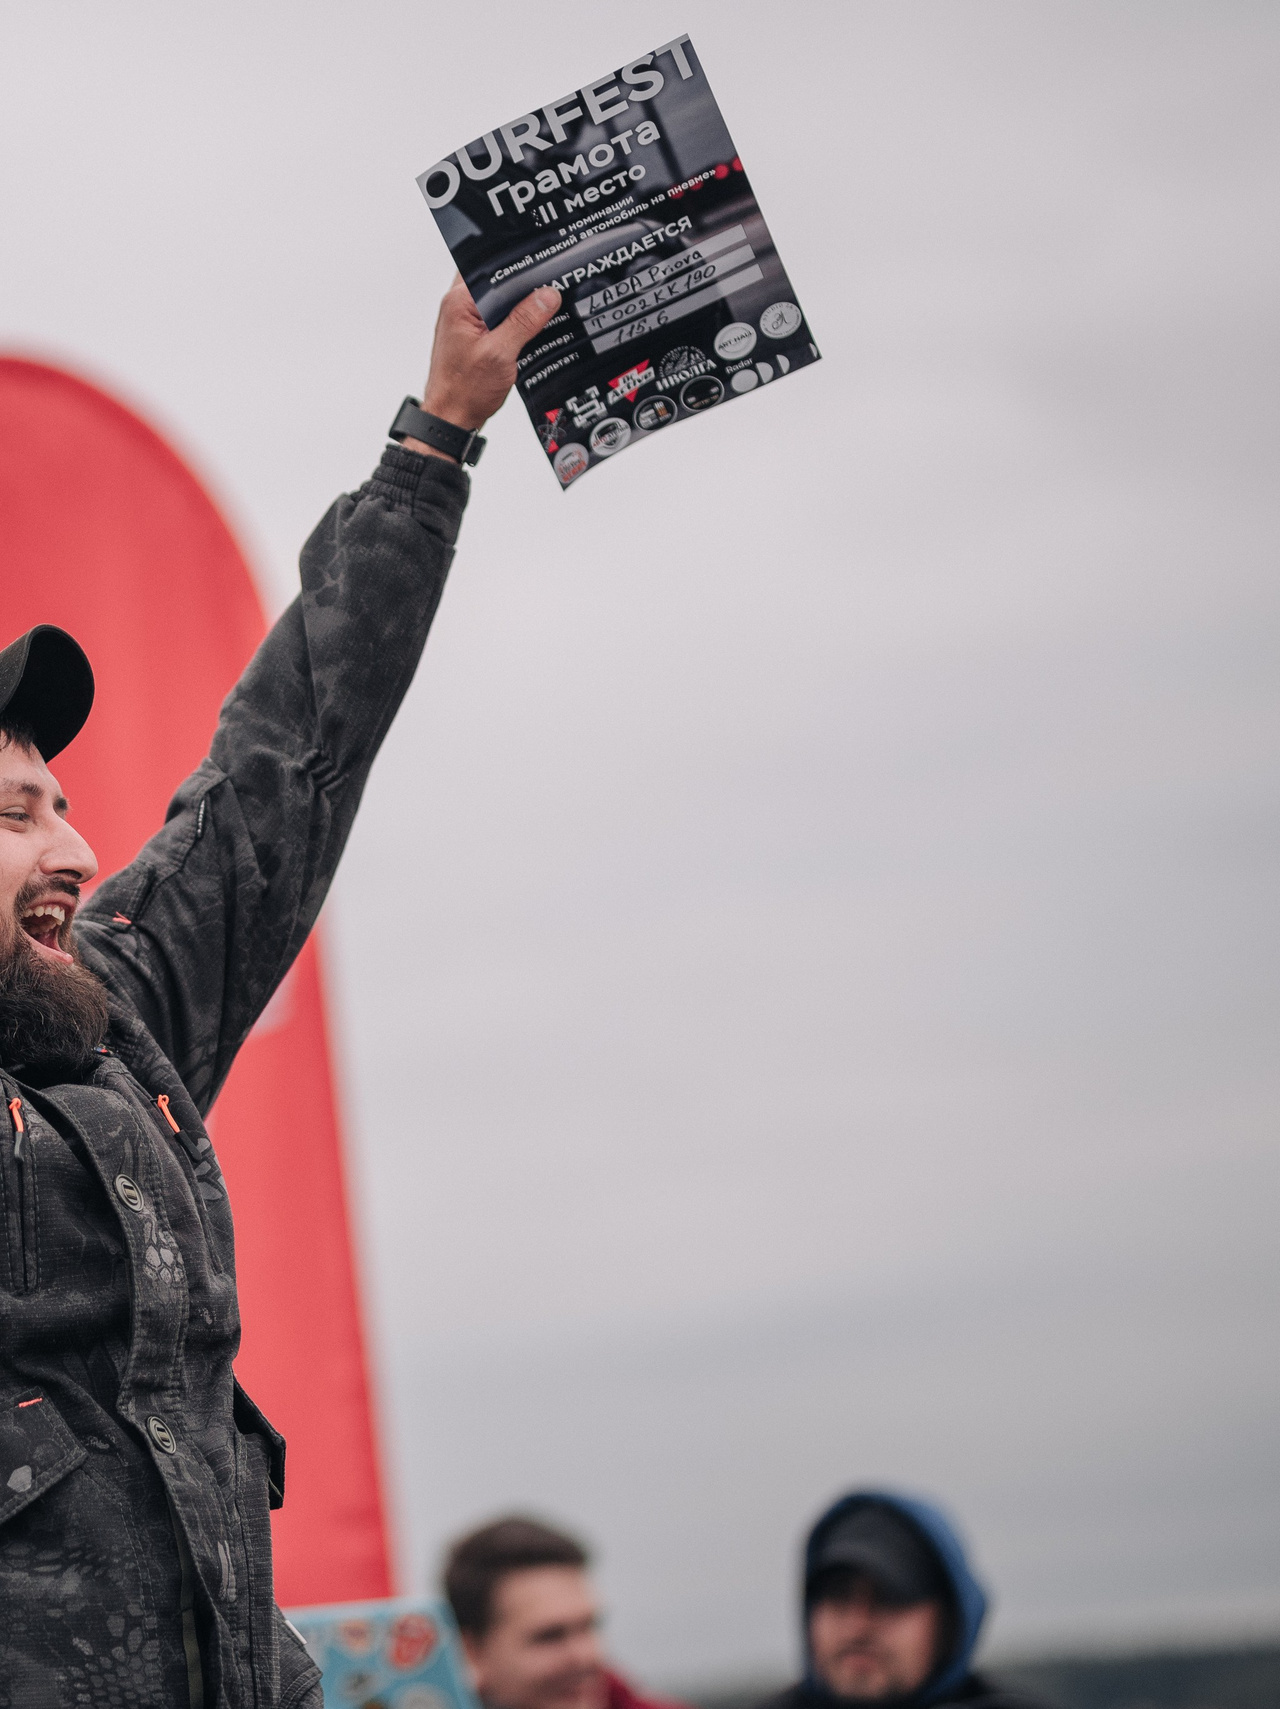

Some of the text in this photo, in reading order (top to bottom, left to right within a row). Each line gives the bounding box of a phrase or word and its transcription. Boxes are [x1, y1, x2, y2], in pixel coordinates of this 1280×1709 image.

[415, 33, 693, 209] OURFEST
[487, 120, 660, 216] Грамота
[564, 164, 646, 213] место
[489, 168, 717, 284] «Самый низкий автомобиль на пневме»
[559, 195, 635, 237] в номинации
[535, 215, 693, 293] АГРАЖДАЕТСЯ
[587, 275, 643, 315] LADA
[611, 297, 651, 320] 002
[683, 264, 717, 292] 190
[524, 351, 580, 390] Результат:
[655, 358, 718, 393] ИВОЛГА
[725, 357, 754, 375] Radar
